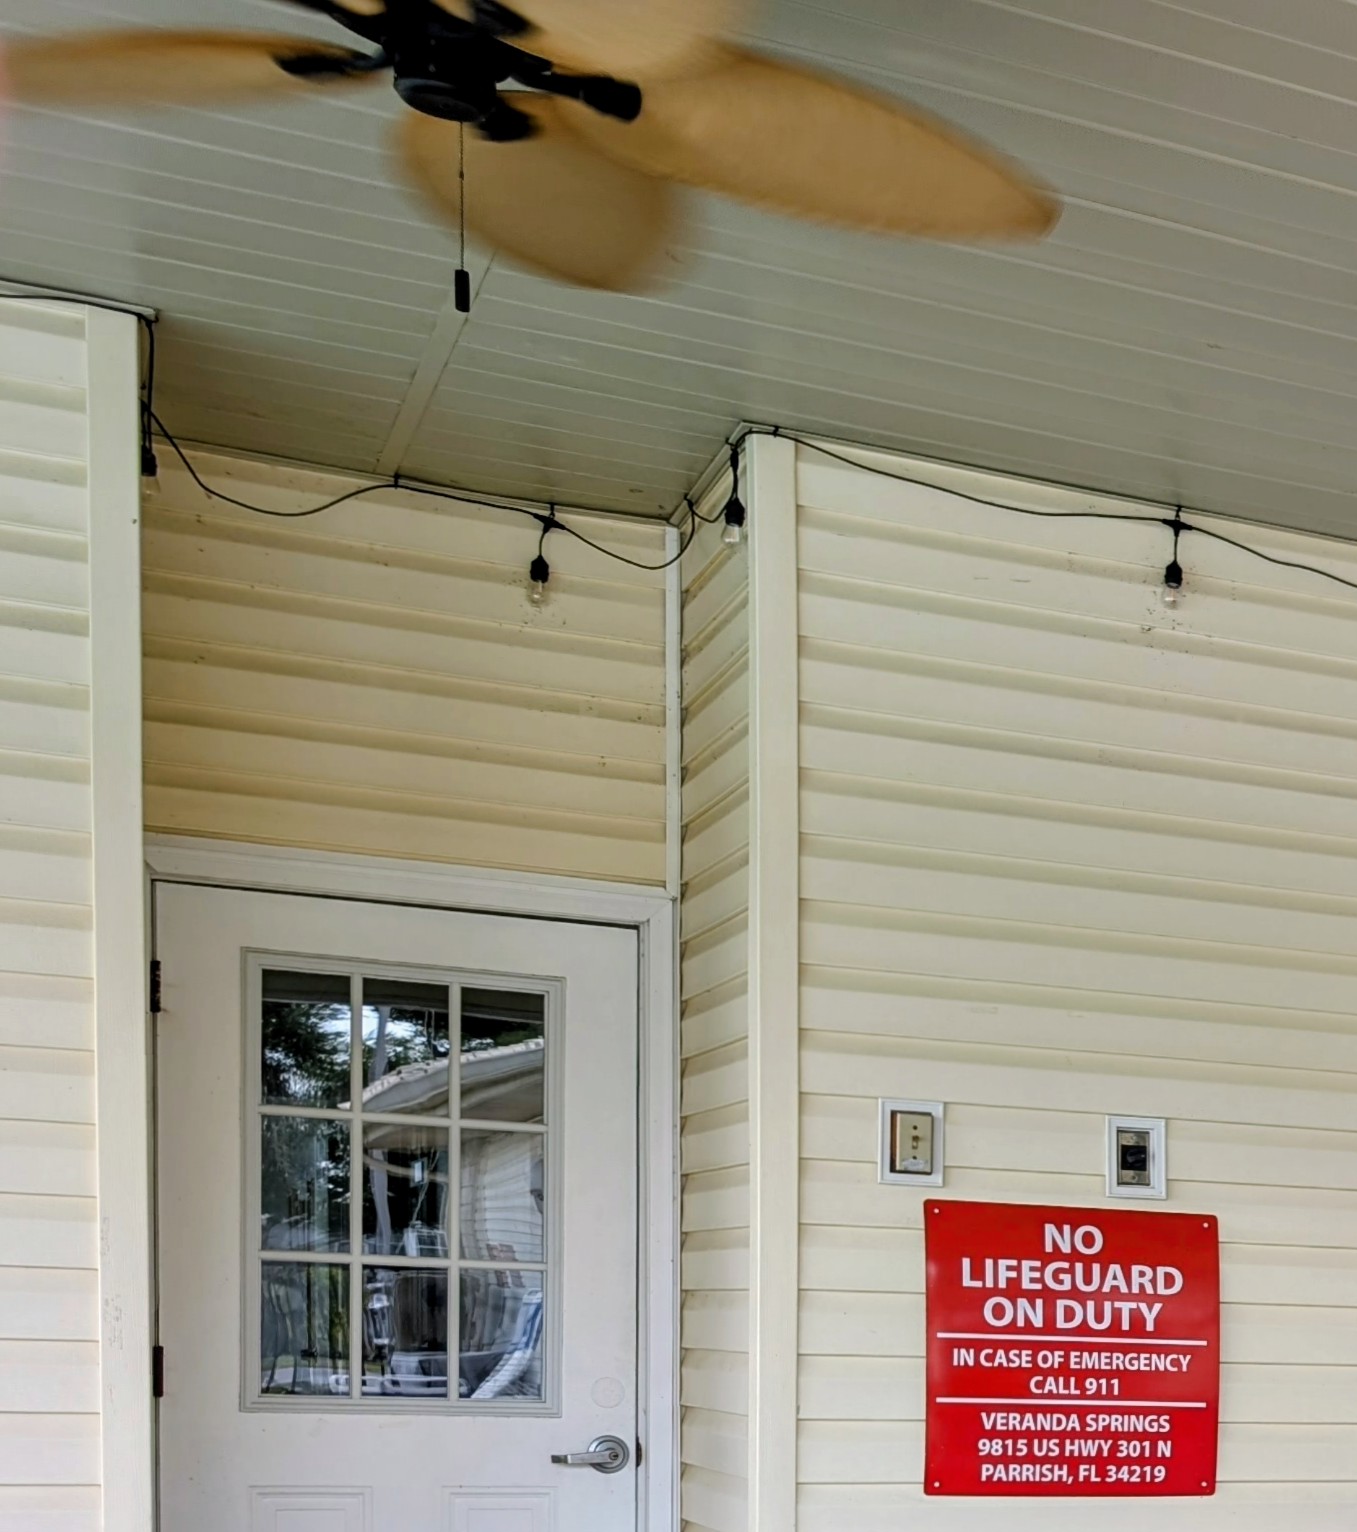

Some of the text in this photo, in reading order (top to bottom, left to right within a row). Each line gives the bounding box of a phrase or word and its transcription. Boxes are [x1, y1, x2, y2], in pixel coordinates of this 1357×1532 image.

[1044, 1223, 1104, 1255] NO
[961, 1257, 1184, 1295] LIFEGUARD
[983, 1296, 1163, 1331] ON DUTY
[952, 1348, 1192, 1372] IN CASE OF EMERGENCY
[1030, 1375, 1119, 1396] CALL 911
[980, 1412, 1171, 1433] VERANDA SPRINGS
[978, 1439, 1171, 1458] 9815 US HWY 301 N
[981, 1464, 1166, 1485] PARRISH, FL 34219
